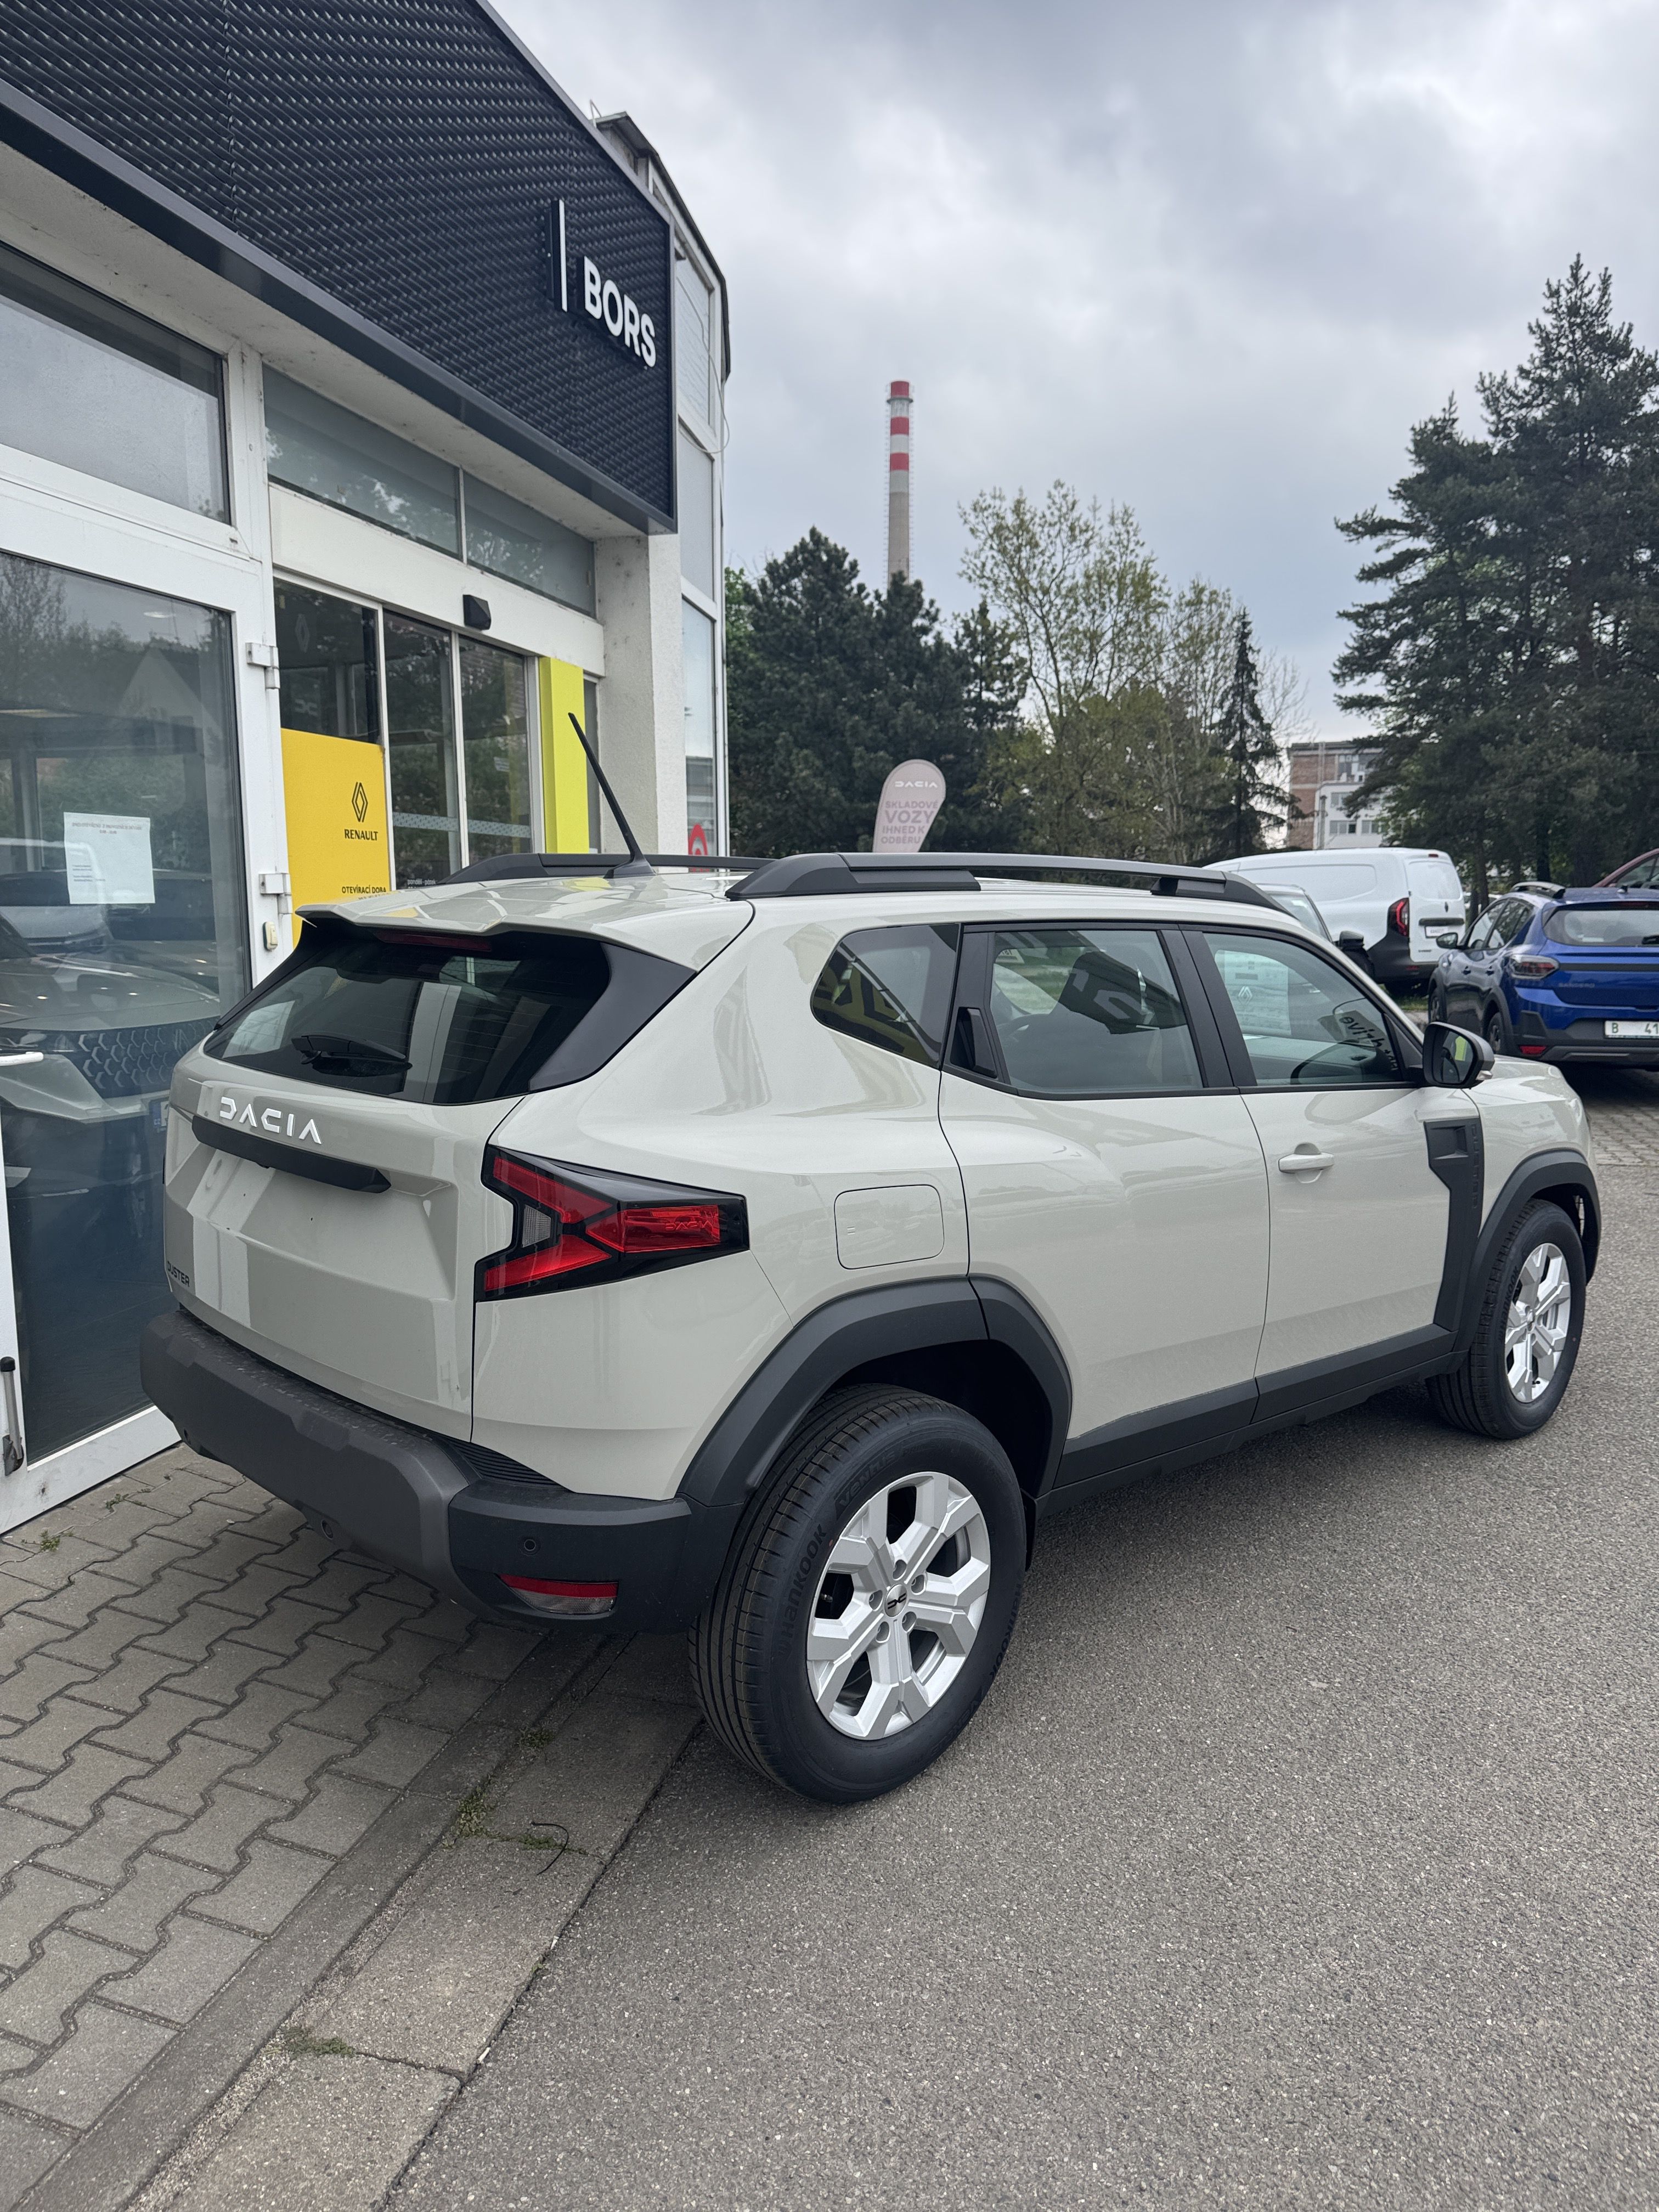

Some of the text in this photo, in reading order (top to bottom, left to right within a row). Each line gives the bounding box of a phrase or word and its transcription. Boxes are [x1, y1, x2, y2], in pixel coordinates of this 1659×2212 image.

[584, 256, 656, 368] BORS
[885, 799, 938, 809] SKLADOVÉ
[884, 810, 934, 823] VOZY
[344, 828, 379, 841] RENAULT
[882, 825, 925, 834] IHNED K
[341, 884, 371, 894] OTEVÍRACÍ
[1611, 1022, 1618, 1034] B
[219, 1096, 322, 1144] DACIA
[167, 1260, 190, 1288] DUSTER
